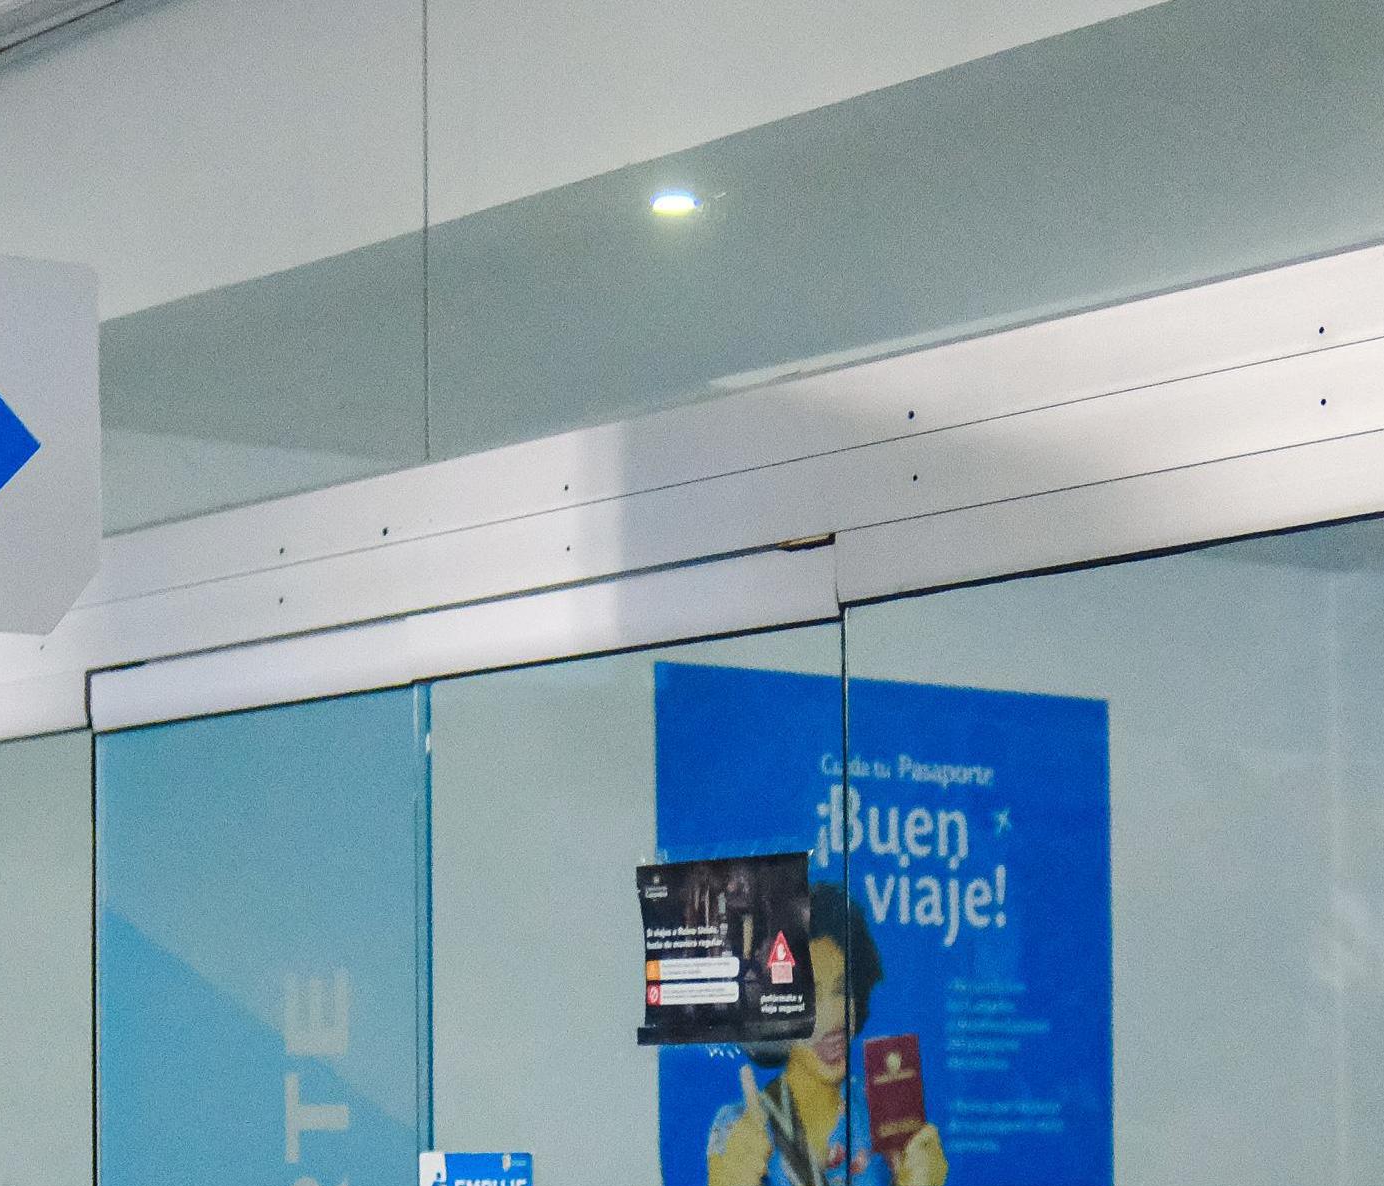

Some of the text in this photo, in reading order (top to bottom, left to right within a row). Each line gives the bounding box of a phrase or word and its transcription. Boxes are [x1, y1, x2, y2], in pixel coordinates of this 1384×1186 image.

[898, 754, 994, 788] Pasaporte
[816, 784, 969, 868] ¡Buen
[864, 854, 1006, 947] viaje!
